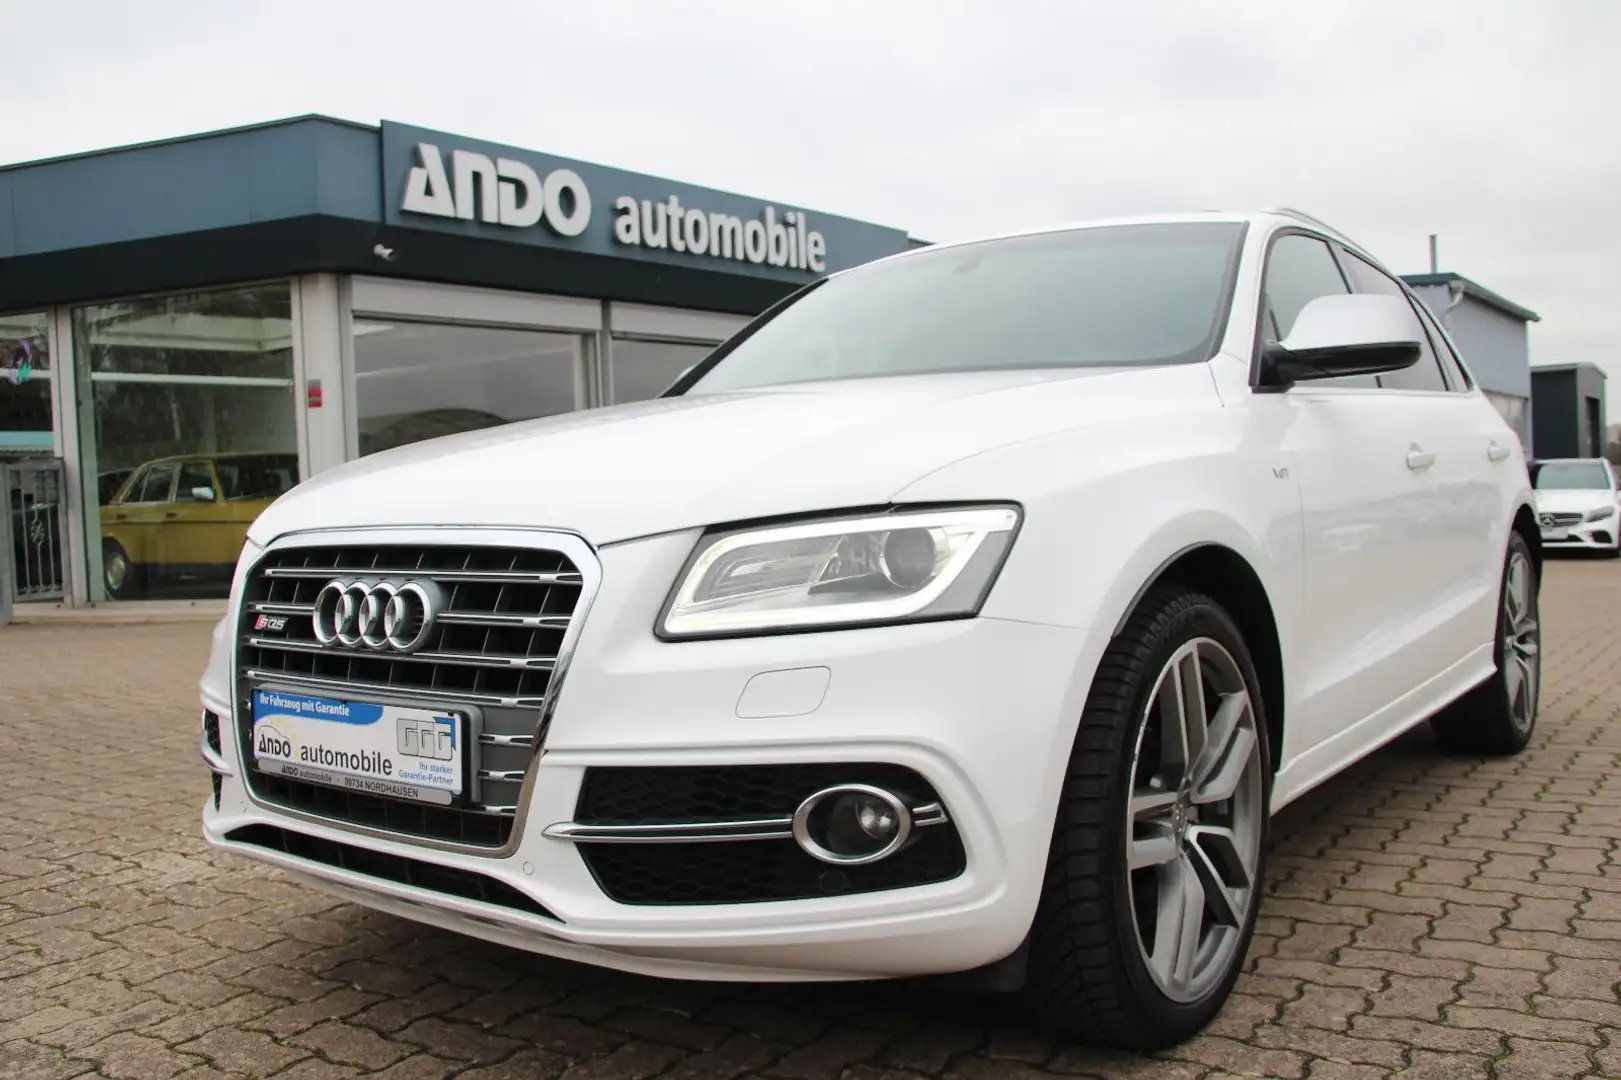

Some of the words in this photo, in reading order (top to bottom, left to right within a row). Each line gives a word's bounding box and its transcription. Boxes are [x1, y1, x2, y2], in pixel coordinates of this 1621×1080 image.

[403, 142, 592, 237] ANDO
[613, 195, 826, 273] automobile
[259, 617, 287, 630] SQ5
[260, 693, 270, 705] Ihr
[270, 695, 302, 713] Fahrzeug
[302, 699, 315, 712] mit
[315, 701, 350, 717] Garantie
[258, 733, 291, 758] ANDO
[301, 743, 393, 776] automobile
[399, 769, 455, 785] Garantie-Partner
[419, 761, 430, 771] Ihr
[430, 763, 453, 775] starker
[281, 765, 299, 777] ANDO
[299, 769, 333, 783] automobile
[364, 780, 419, 798] NORDHAUSEN
